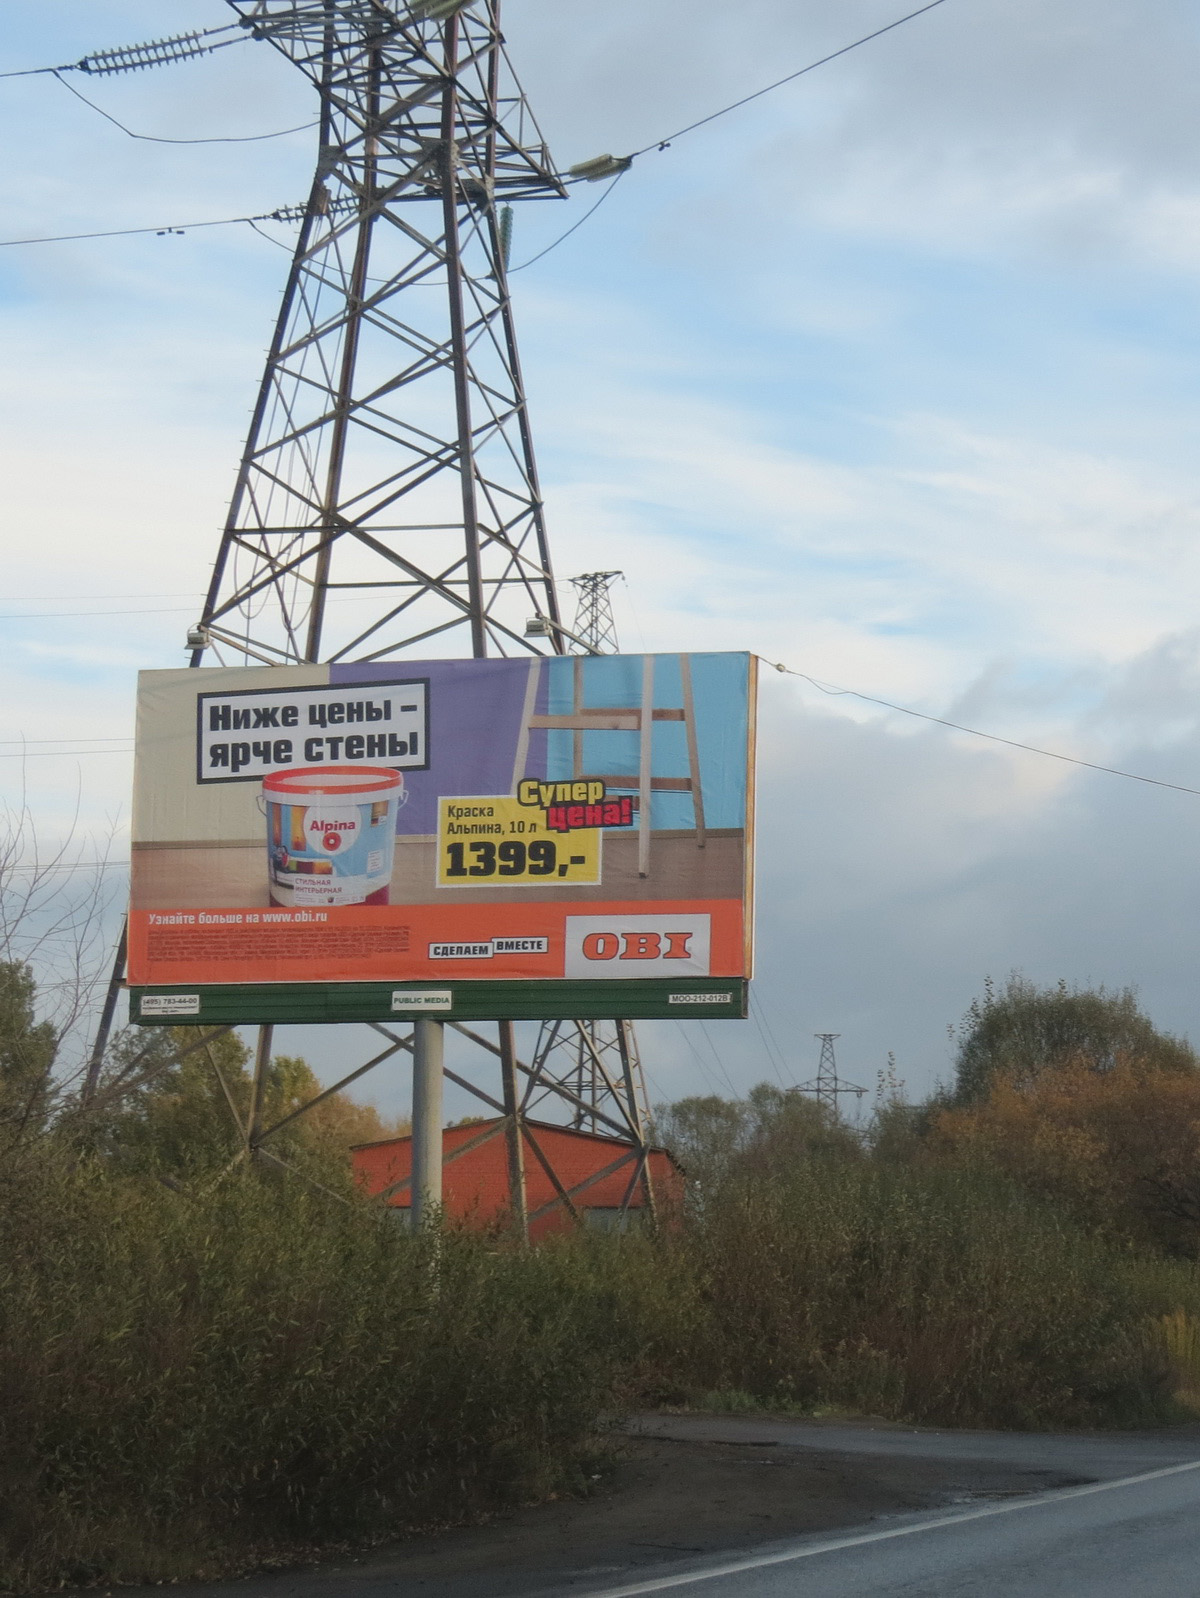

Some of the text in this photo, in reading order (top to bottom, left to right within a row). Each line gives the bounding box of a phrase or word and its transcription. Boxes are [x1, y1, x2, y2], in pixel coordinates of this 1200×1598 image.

[209, 704, 299, 732] Ниже
[308, 699, 392, 729] цены
[209, 731, 419, 773] ярче стены
[518, 780, 605, 808] Супер
[447, 805, 495, 819] Краска
[547, 797, 632, 832] цена!
[309, 820, 356, 834] Alpina
[447, 821, 538, 836] Альпина, 10 л
[446, 840, 586, 877] 1399,-
[294, 878, 332, 887] СТИЛЬНАЯ
[294, 886, 343, 895] ИНТЕРЬЕРНАЯ
[148, 909, 329, 925] Узнайте больше на www.obi.ru
[433, 940, 543, 957] СДЕЛАЕМ ВМЕСТЕ
[582, 932, 693, 960] OBI
[424, 996, 450, 1004] MEDIA
